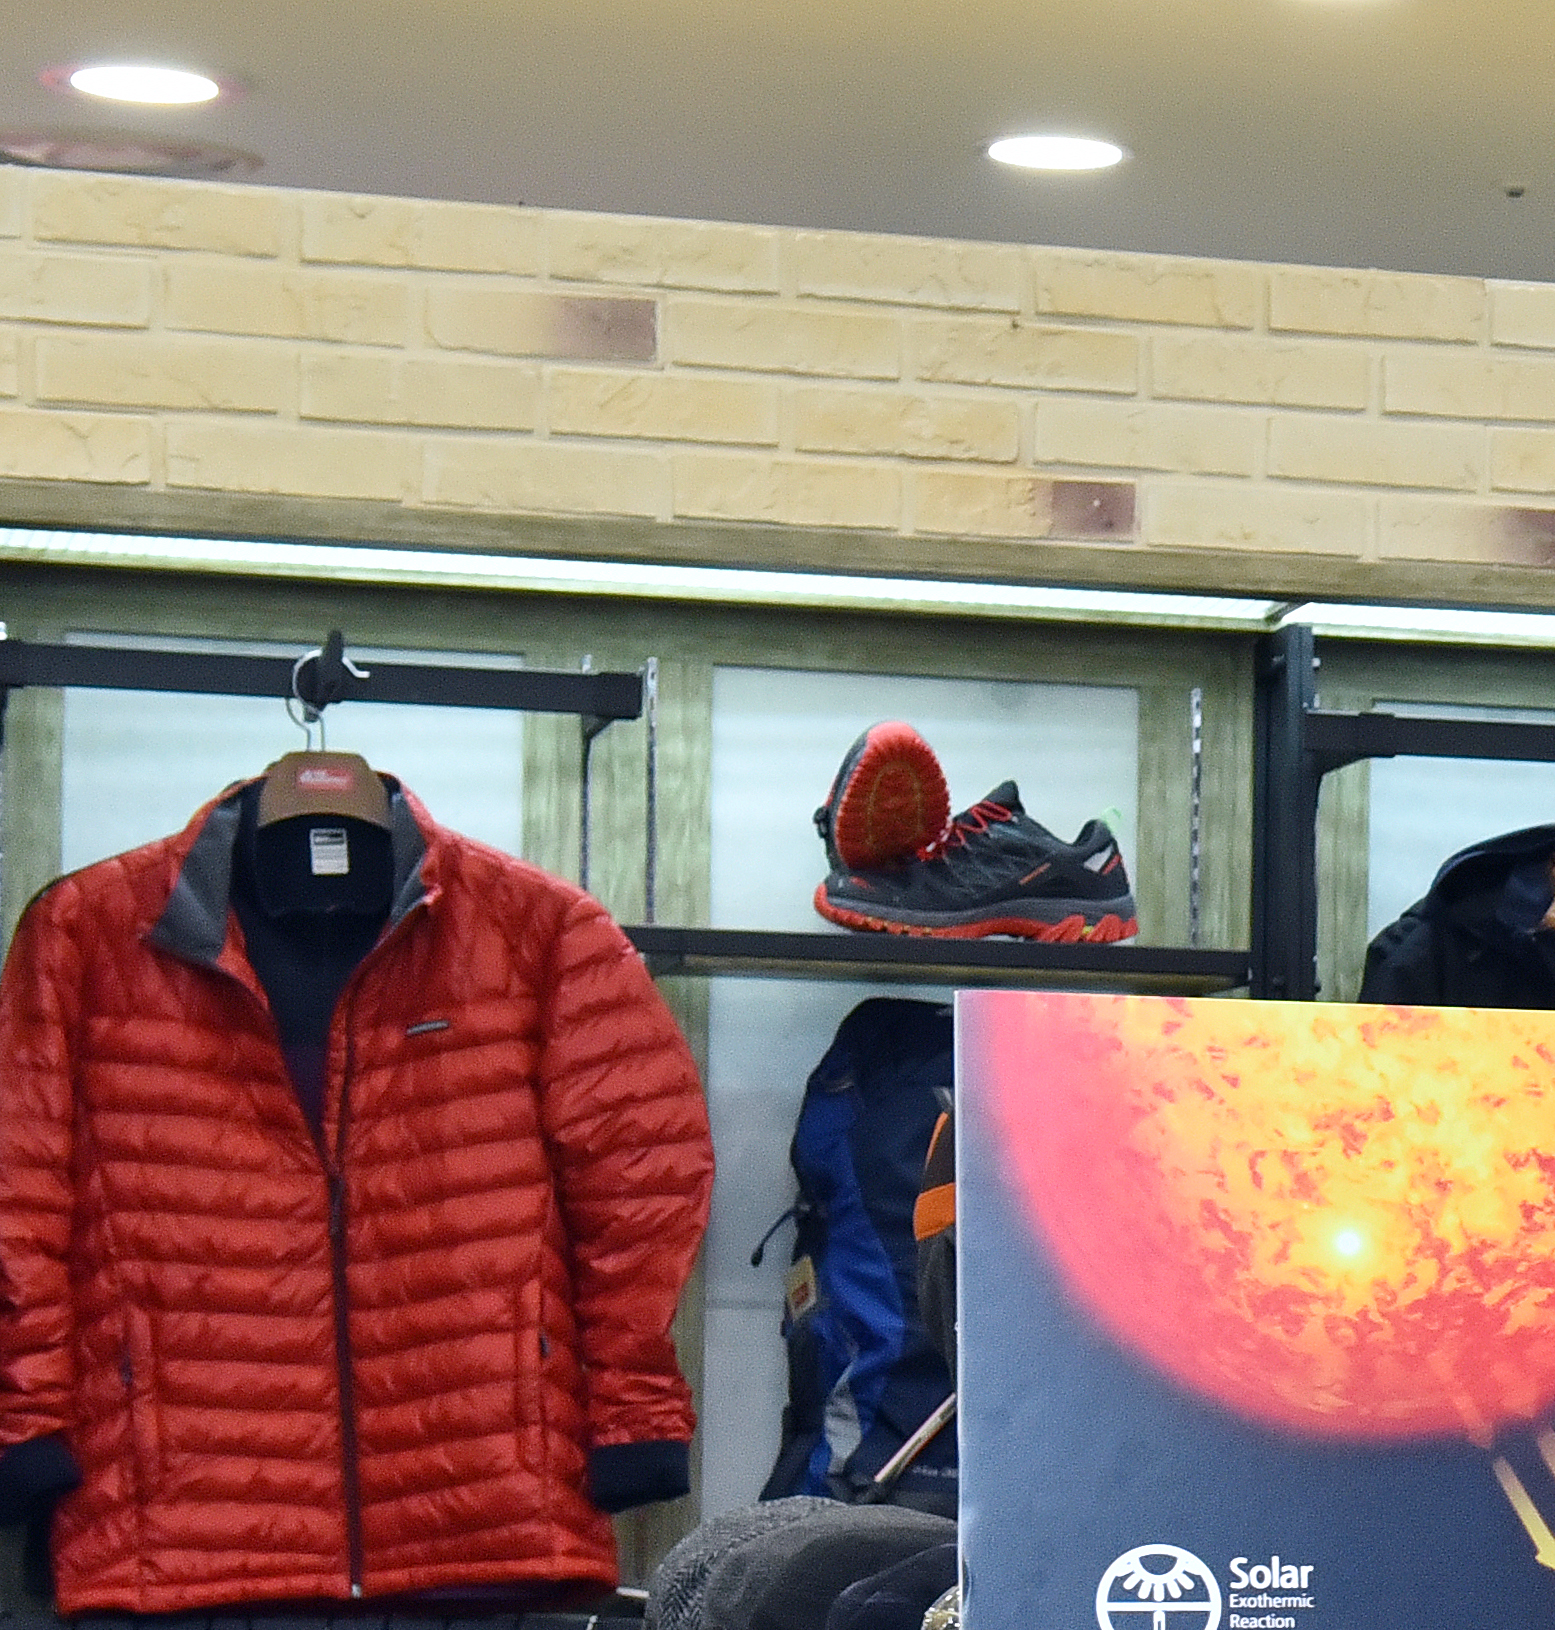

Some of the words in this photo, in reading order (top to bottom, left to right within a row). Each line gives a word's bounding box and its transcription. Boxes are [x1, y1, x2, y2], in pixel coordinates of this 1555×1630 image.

[1229, 1555, 1315, 1590] Solar
[1229, 1592, 1316, 1609] Exothermic
[1229, 1612, 1296, 1629] Reaction
